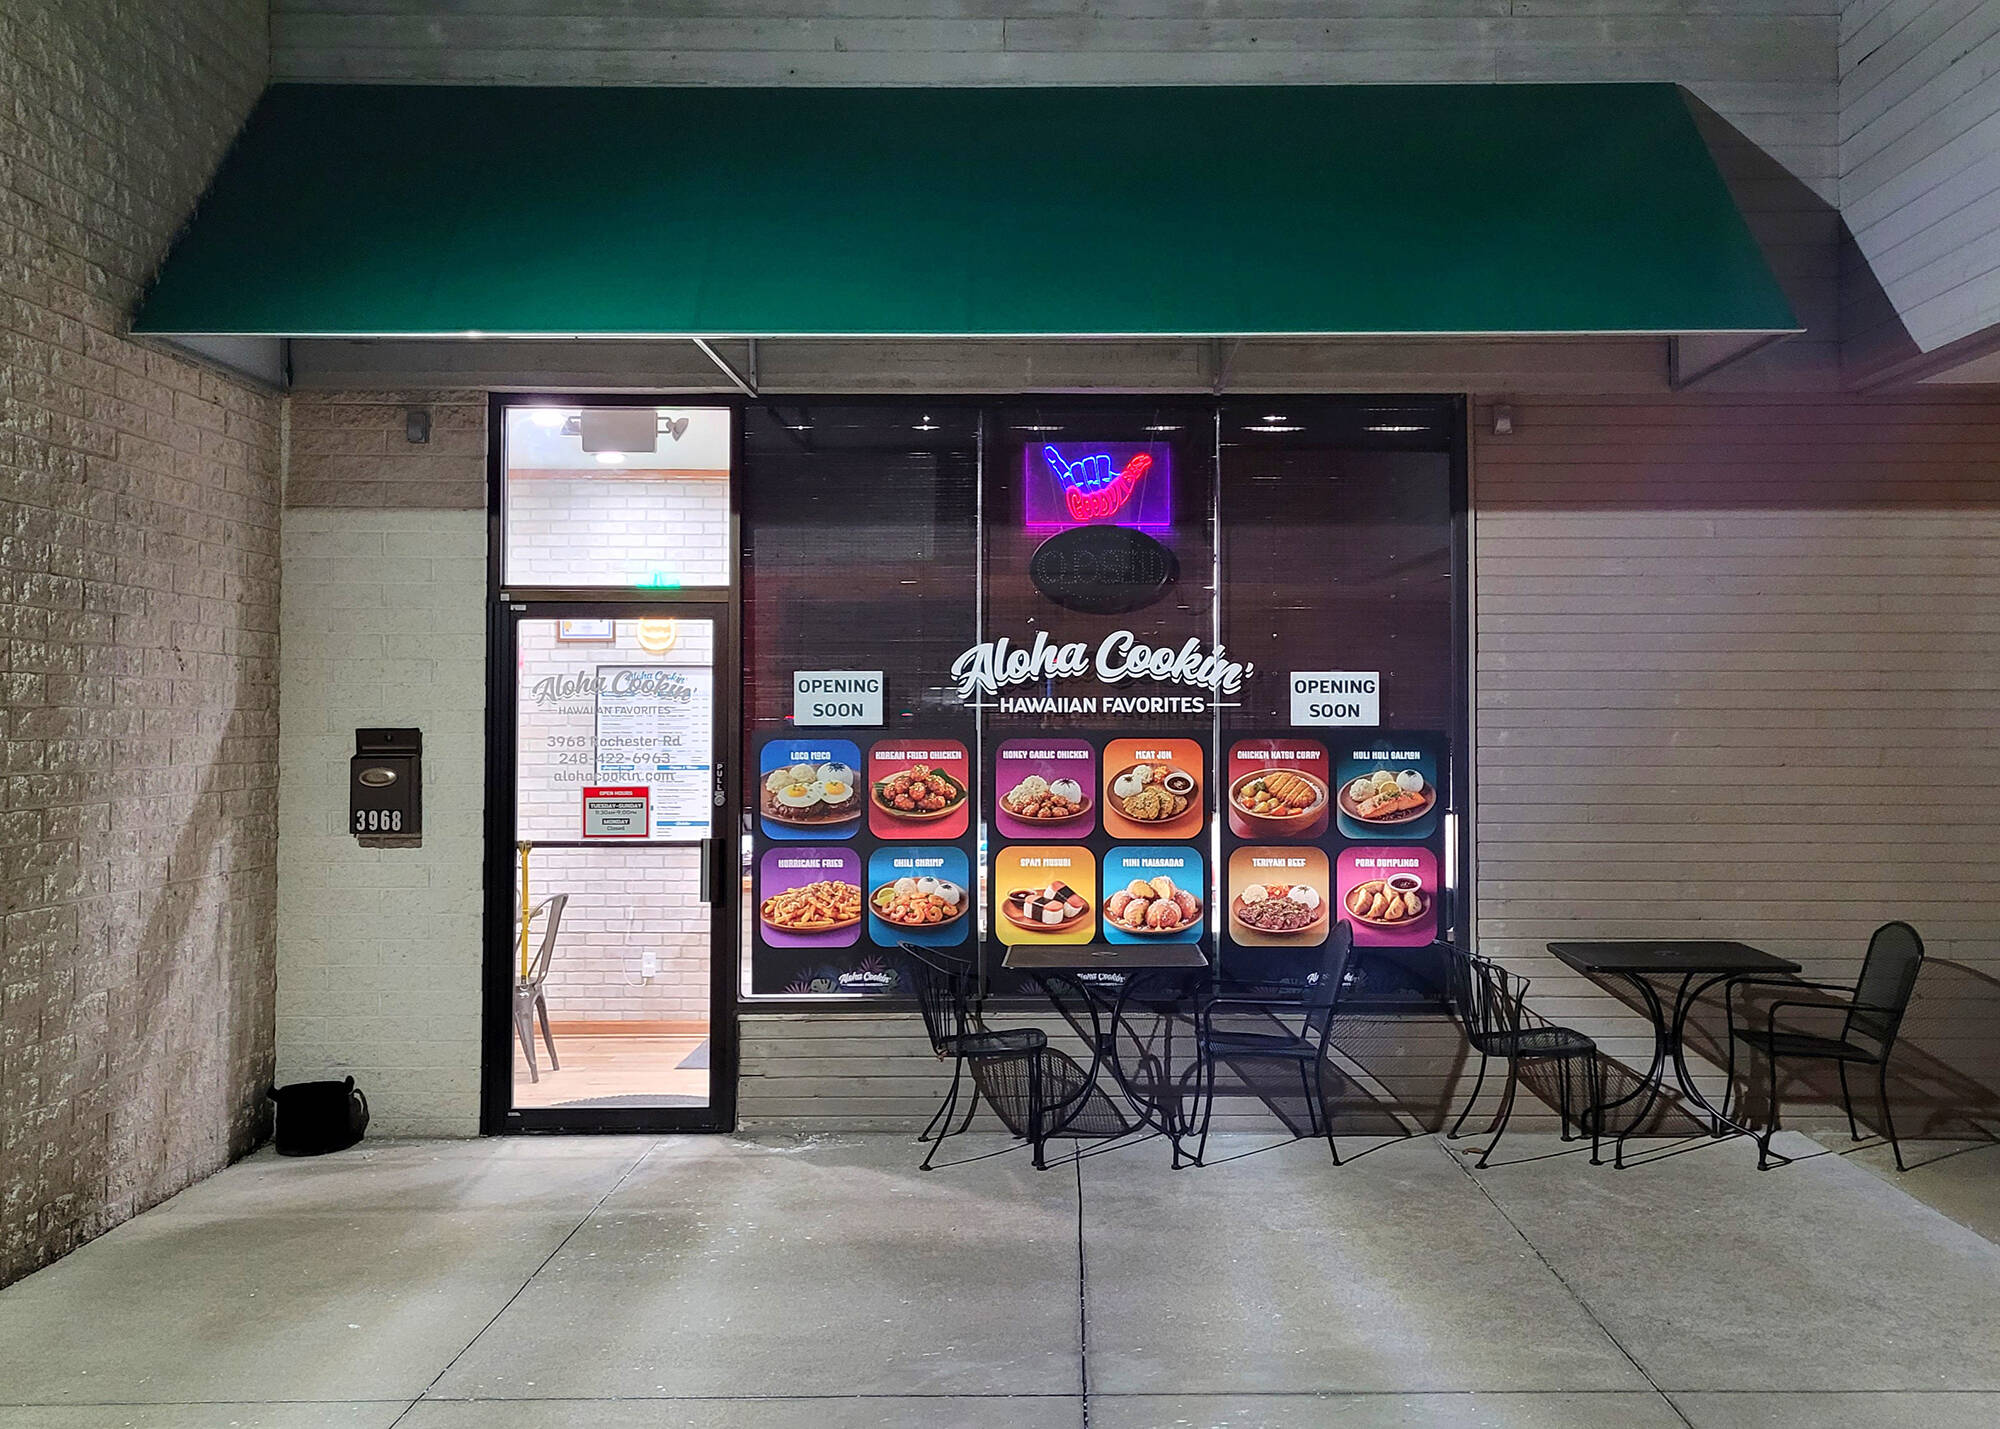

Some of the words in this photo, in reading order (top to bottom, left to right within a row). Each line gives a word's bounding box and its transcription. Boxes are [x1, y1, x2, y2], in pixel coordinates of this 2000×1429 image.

[951, 631, 1090, 699] Aloha
[1095, 630, 1254, 695] Cookin'
[532, 670, 607, 707] Aloha
[799, 679, 879, 693] OPENING
[1295, 680, 1375, 693] OPENING
[614, 706, 671, 715] FAVORITES
[813, 703, 863, 717] SOON
[1000, 697, 1097, 713] HAWAIIAN
[1102, 697, 1205, 713] FAVORITES
[1309, 704, 1360, 717] SOON
[547, 736, 586, 747] 3968
[590, 735, 658, 747] Rochester
[662, 735, 682, 747] Rd
[559, 752, 670, 764] 248-422-6963
[790, 751, 809, 760] LOCO
[930, 751, 962, 760] CHICKEN
[1003, 750, 1027, 759] HONEY
[1029, 750, 1055, 759] GARLIC
[1057, 750, 1089, 759] CHICKEN
[1135, 750, 1155, 760] MEAT
[1237, 751, 1269, 760] CHICKEN
[553, 770, 675, 782] alohacookin.com
[716, 763, 724, 791] PULL
[356, 810, 402, 831] 3968
